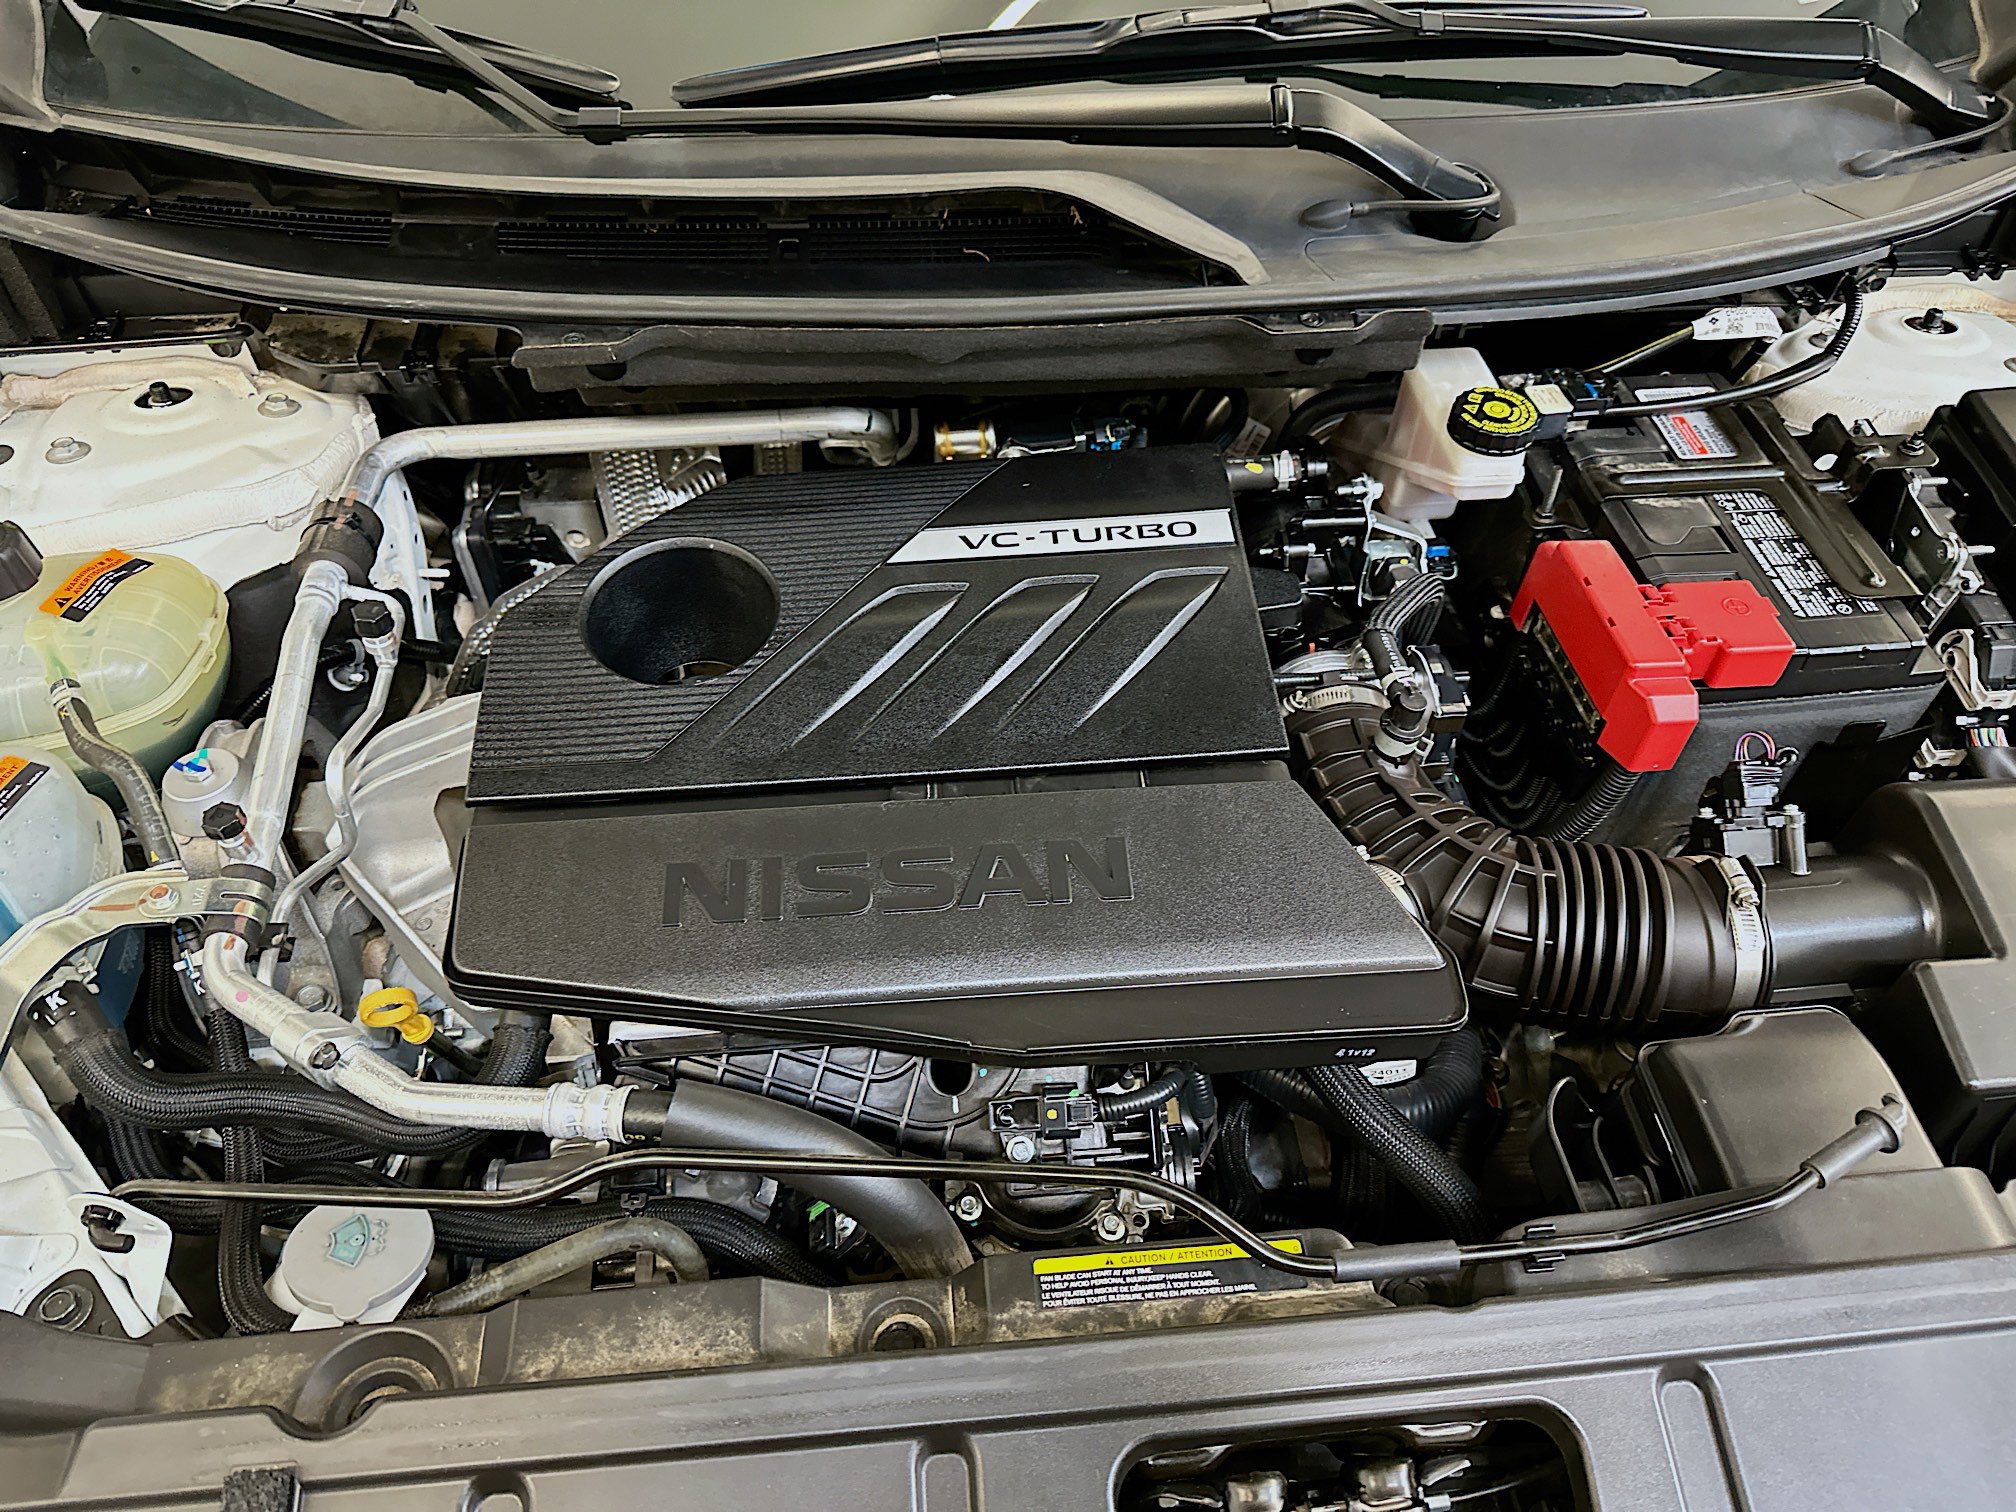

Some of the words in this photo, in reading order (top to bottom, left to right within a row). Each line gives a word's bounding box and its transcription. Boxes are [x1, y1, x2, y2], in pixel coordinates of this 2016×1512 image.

[958, 520, 1198, 551] VC-TURBO
[64, 567, 94, 592] WARNING
[661, 836, 1134, 927] NISSAN
[1121, 1253, 1166, 1264] CAUTION
[1178, 1248, 1233, 1259] ATTENTION
[1092, 1270, 1112, 1278] START
[1069, 1280, 1090, 1288] AVOID
[1091, 1278, 1125, 1286] PERSONAL
[1051, 1288, 1093, 1298] VENTILATEUR
[1086, 1295, 1108, 1303] TOUTE
[1155, 1290, 1169, 1298] PAS
[1180, 1286, 1221, 1296] APPROCHER
[1221, 1285, 1233, 1293] LES
